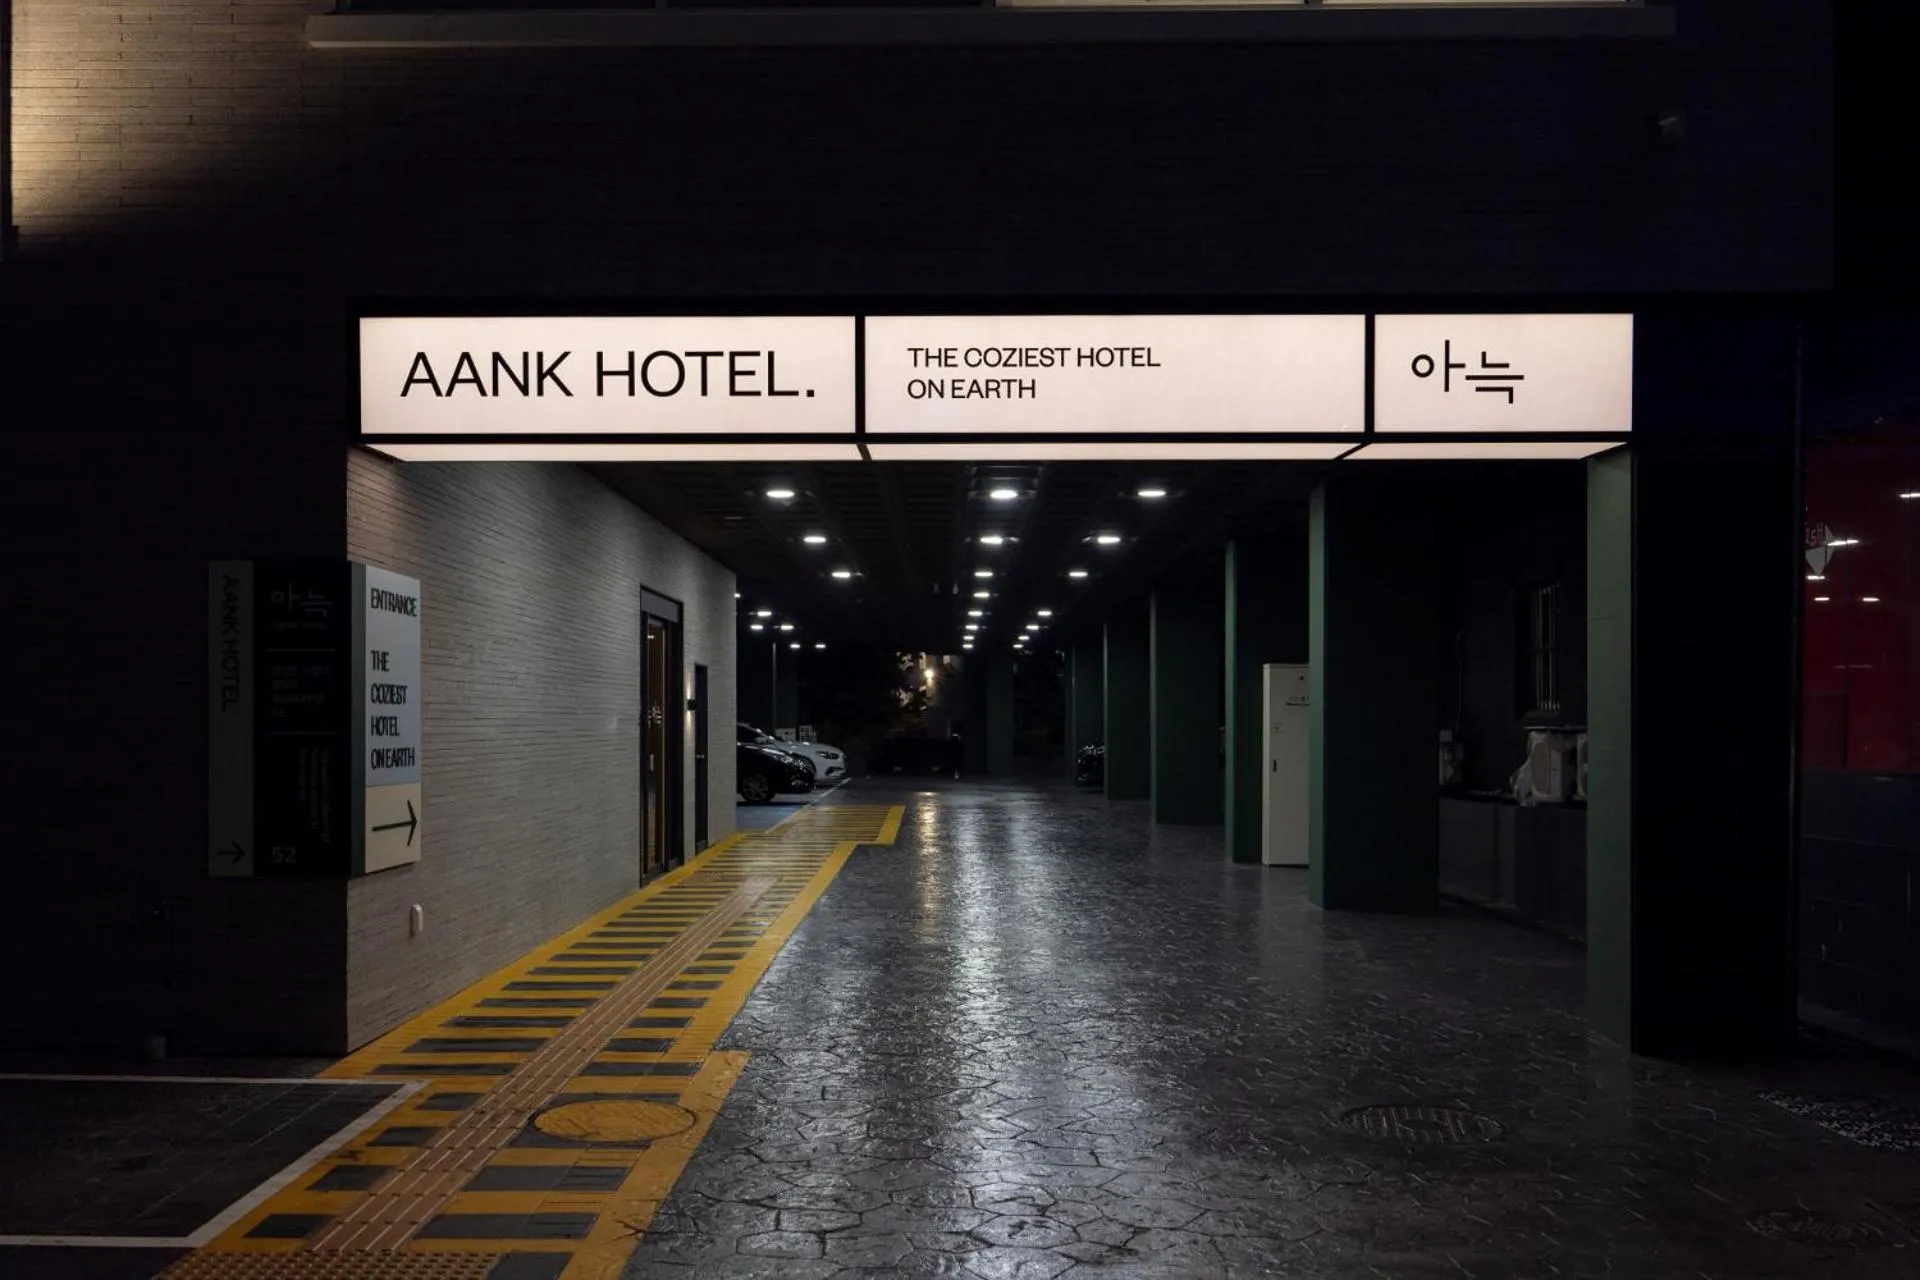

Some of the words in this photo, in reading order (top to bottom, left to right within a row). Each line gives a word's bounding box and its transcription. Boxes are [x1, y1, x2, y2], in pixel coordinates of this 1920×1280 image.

[907, 347, 958, 368] THE
[963, 346, 1072, 368] COZIEST
[1077, 346, 1162, 368] HOTEL
[400, 351, 573, 398] AANK
[596, 350, 815, 398] HOTEL.
[1411, 339, 1525, 405] 아늑
[907, 378, 945, 400] ON
[951, 378, 1036, 400] EARTH
[221, 573, 239, 635] AANK
[370, 588, 417, 617] ENTRANCE
[370, 650, 390, 672] THE
[221, 639, 239, 713] HOTEL
[370, 683, 408, 706] COZIEST
[370, 715, 400, 737] HOTEL
[370, 748, 384, 770] ON
[385, 746, 415, 769] EARTH
[271, 845, 297, 865] 52
